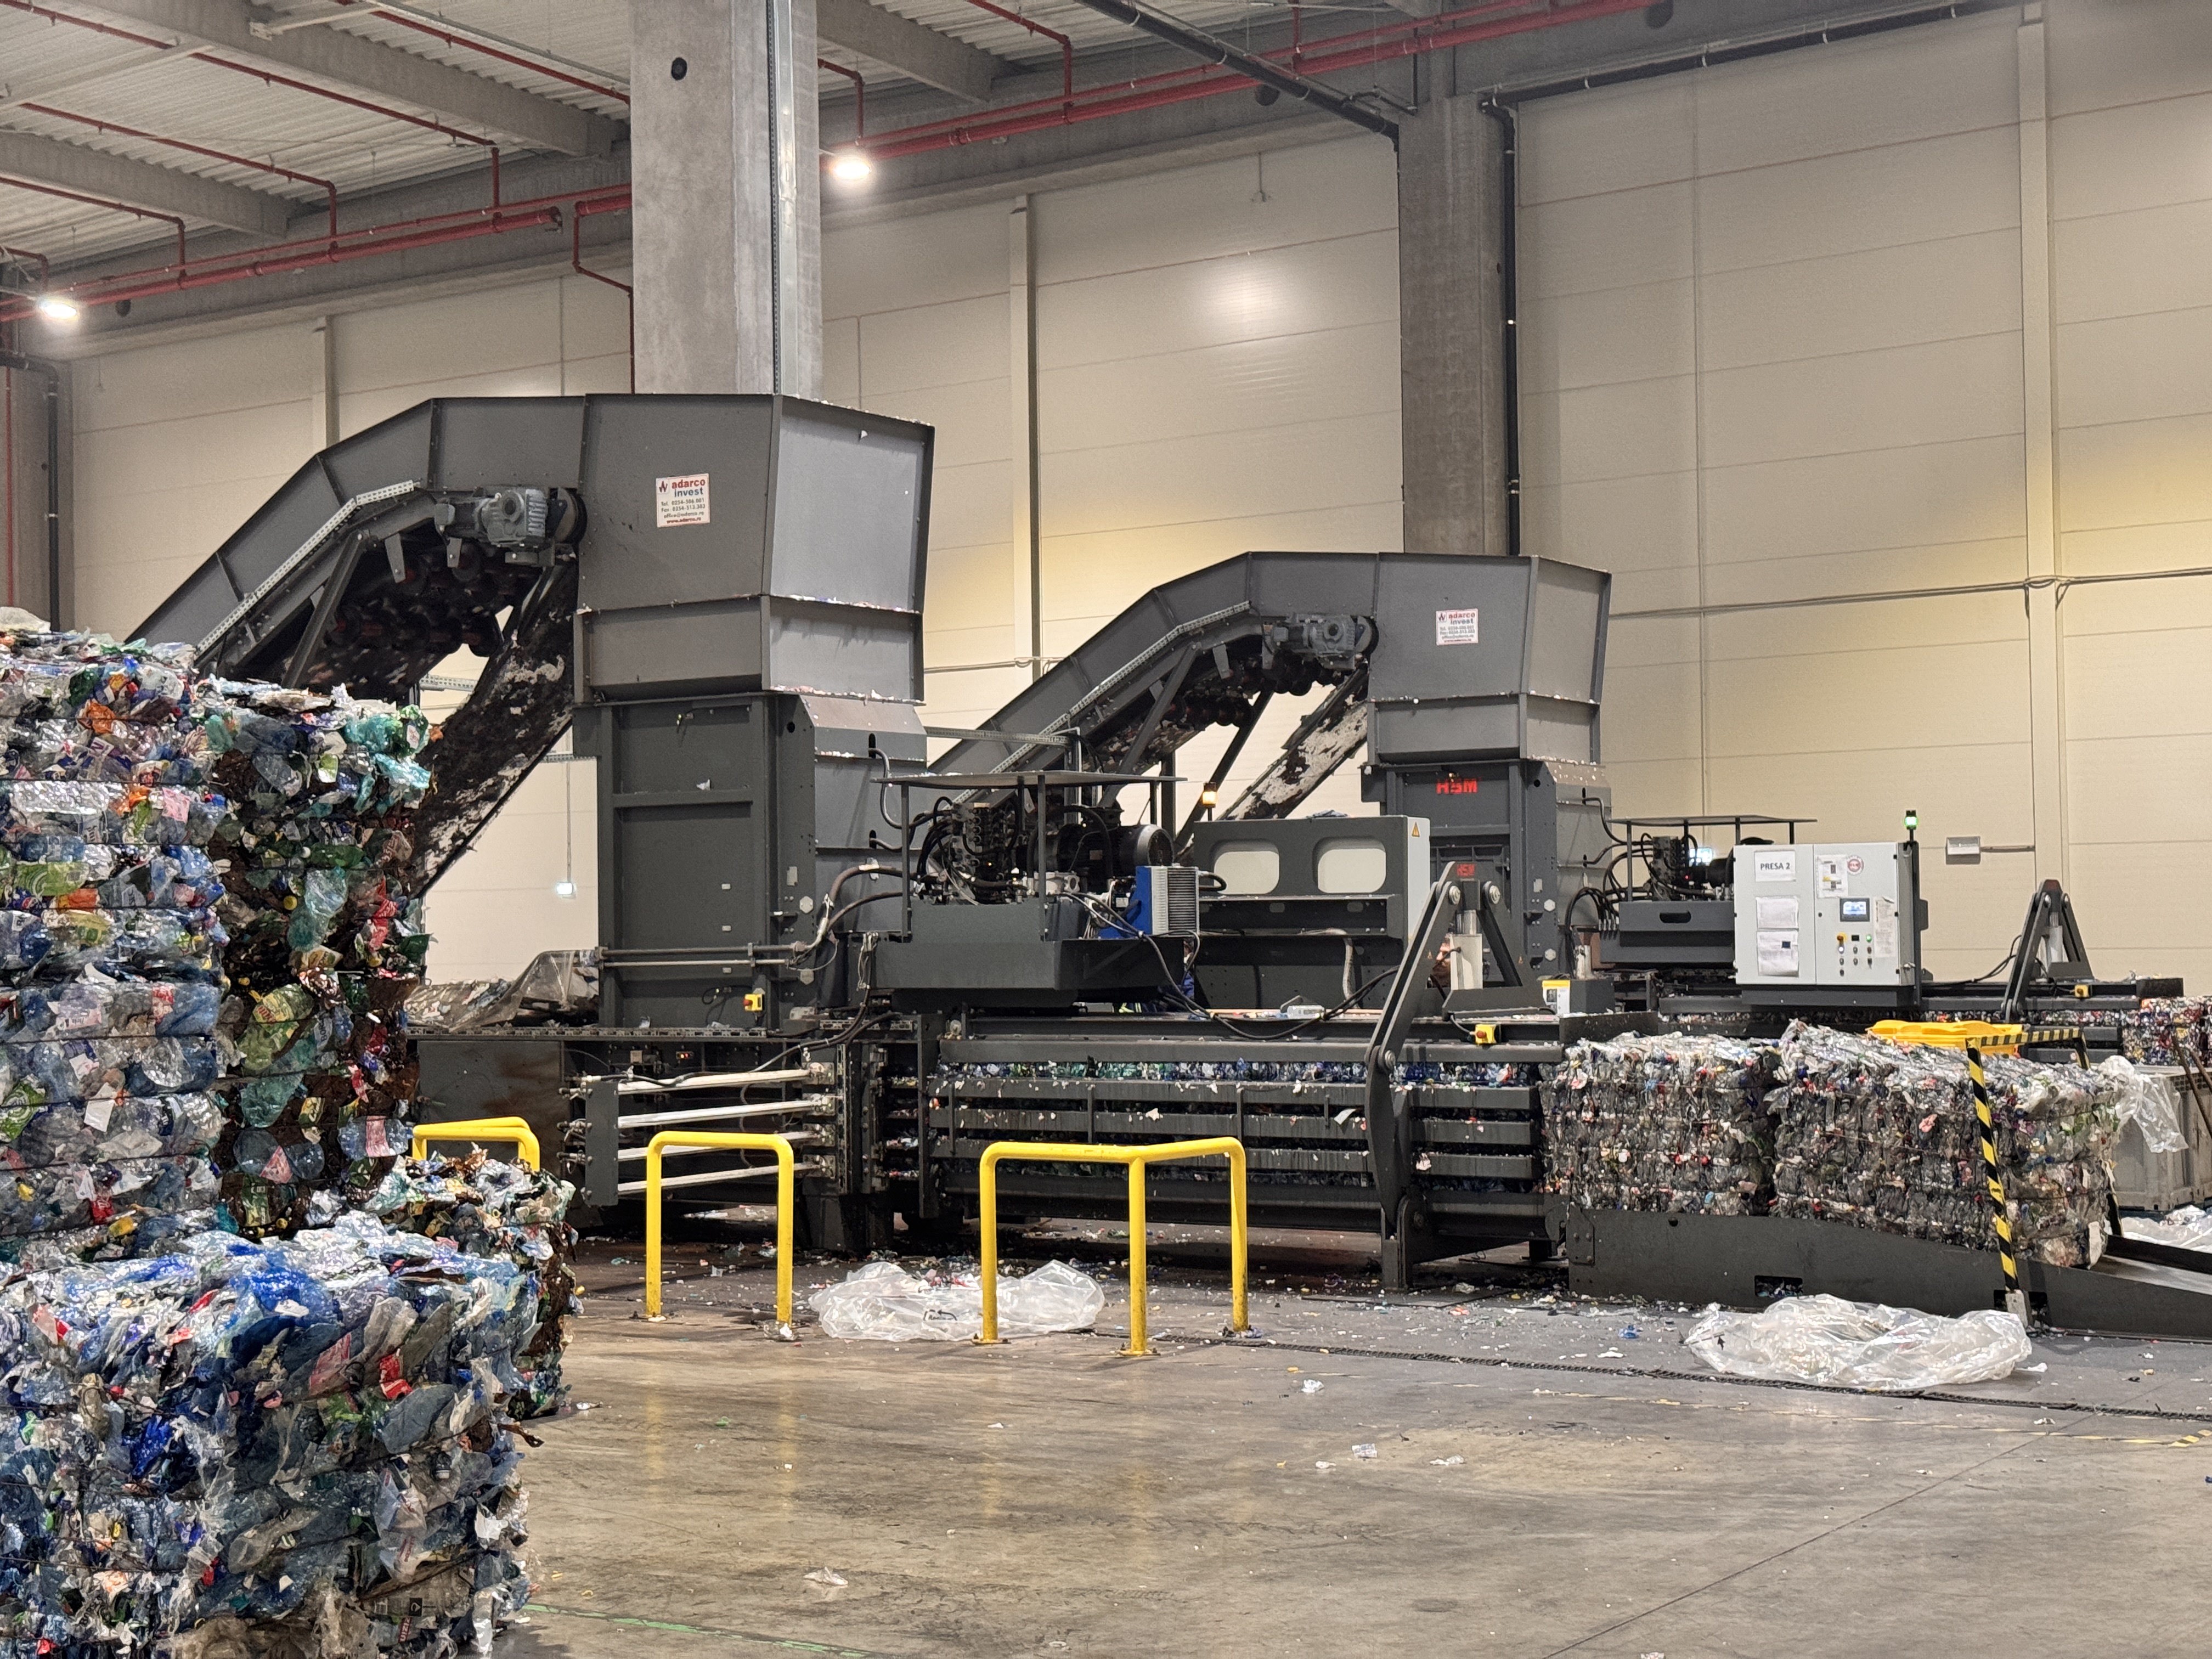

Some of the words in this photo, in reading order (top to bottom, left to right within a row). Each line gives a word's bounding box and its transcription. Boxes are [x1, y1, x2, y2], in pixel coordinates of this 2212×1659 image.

[672, 479, 706, 489] adarco
[674, 487, 703, 497] invest
[1436, 778, 1478, 794] HSM
[1760, 862, 1784, 871] PRESA
